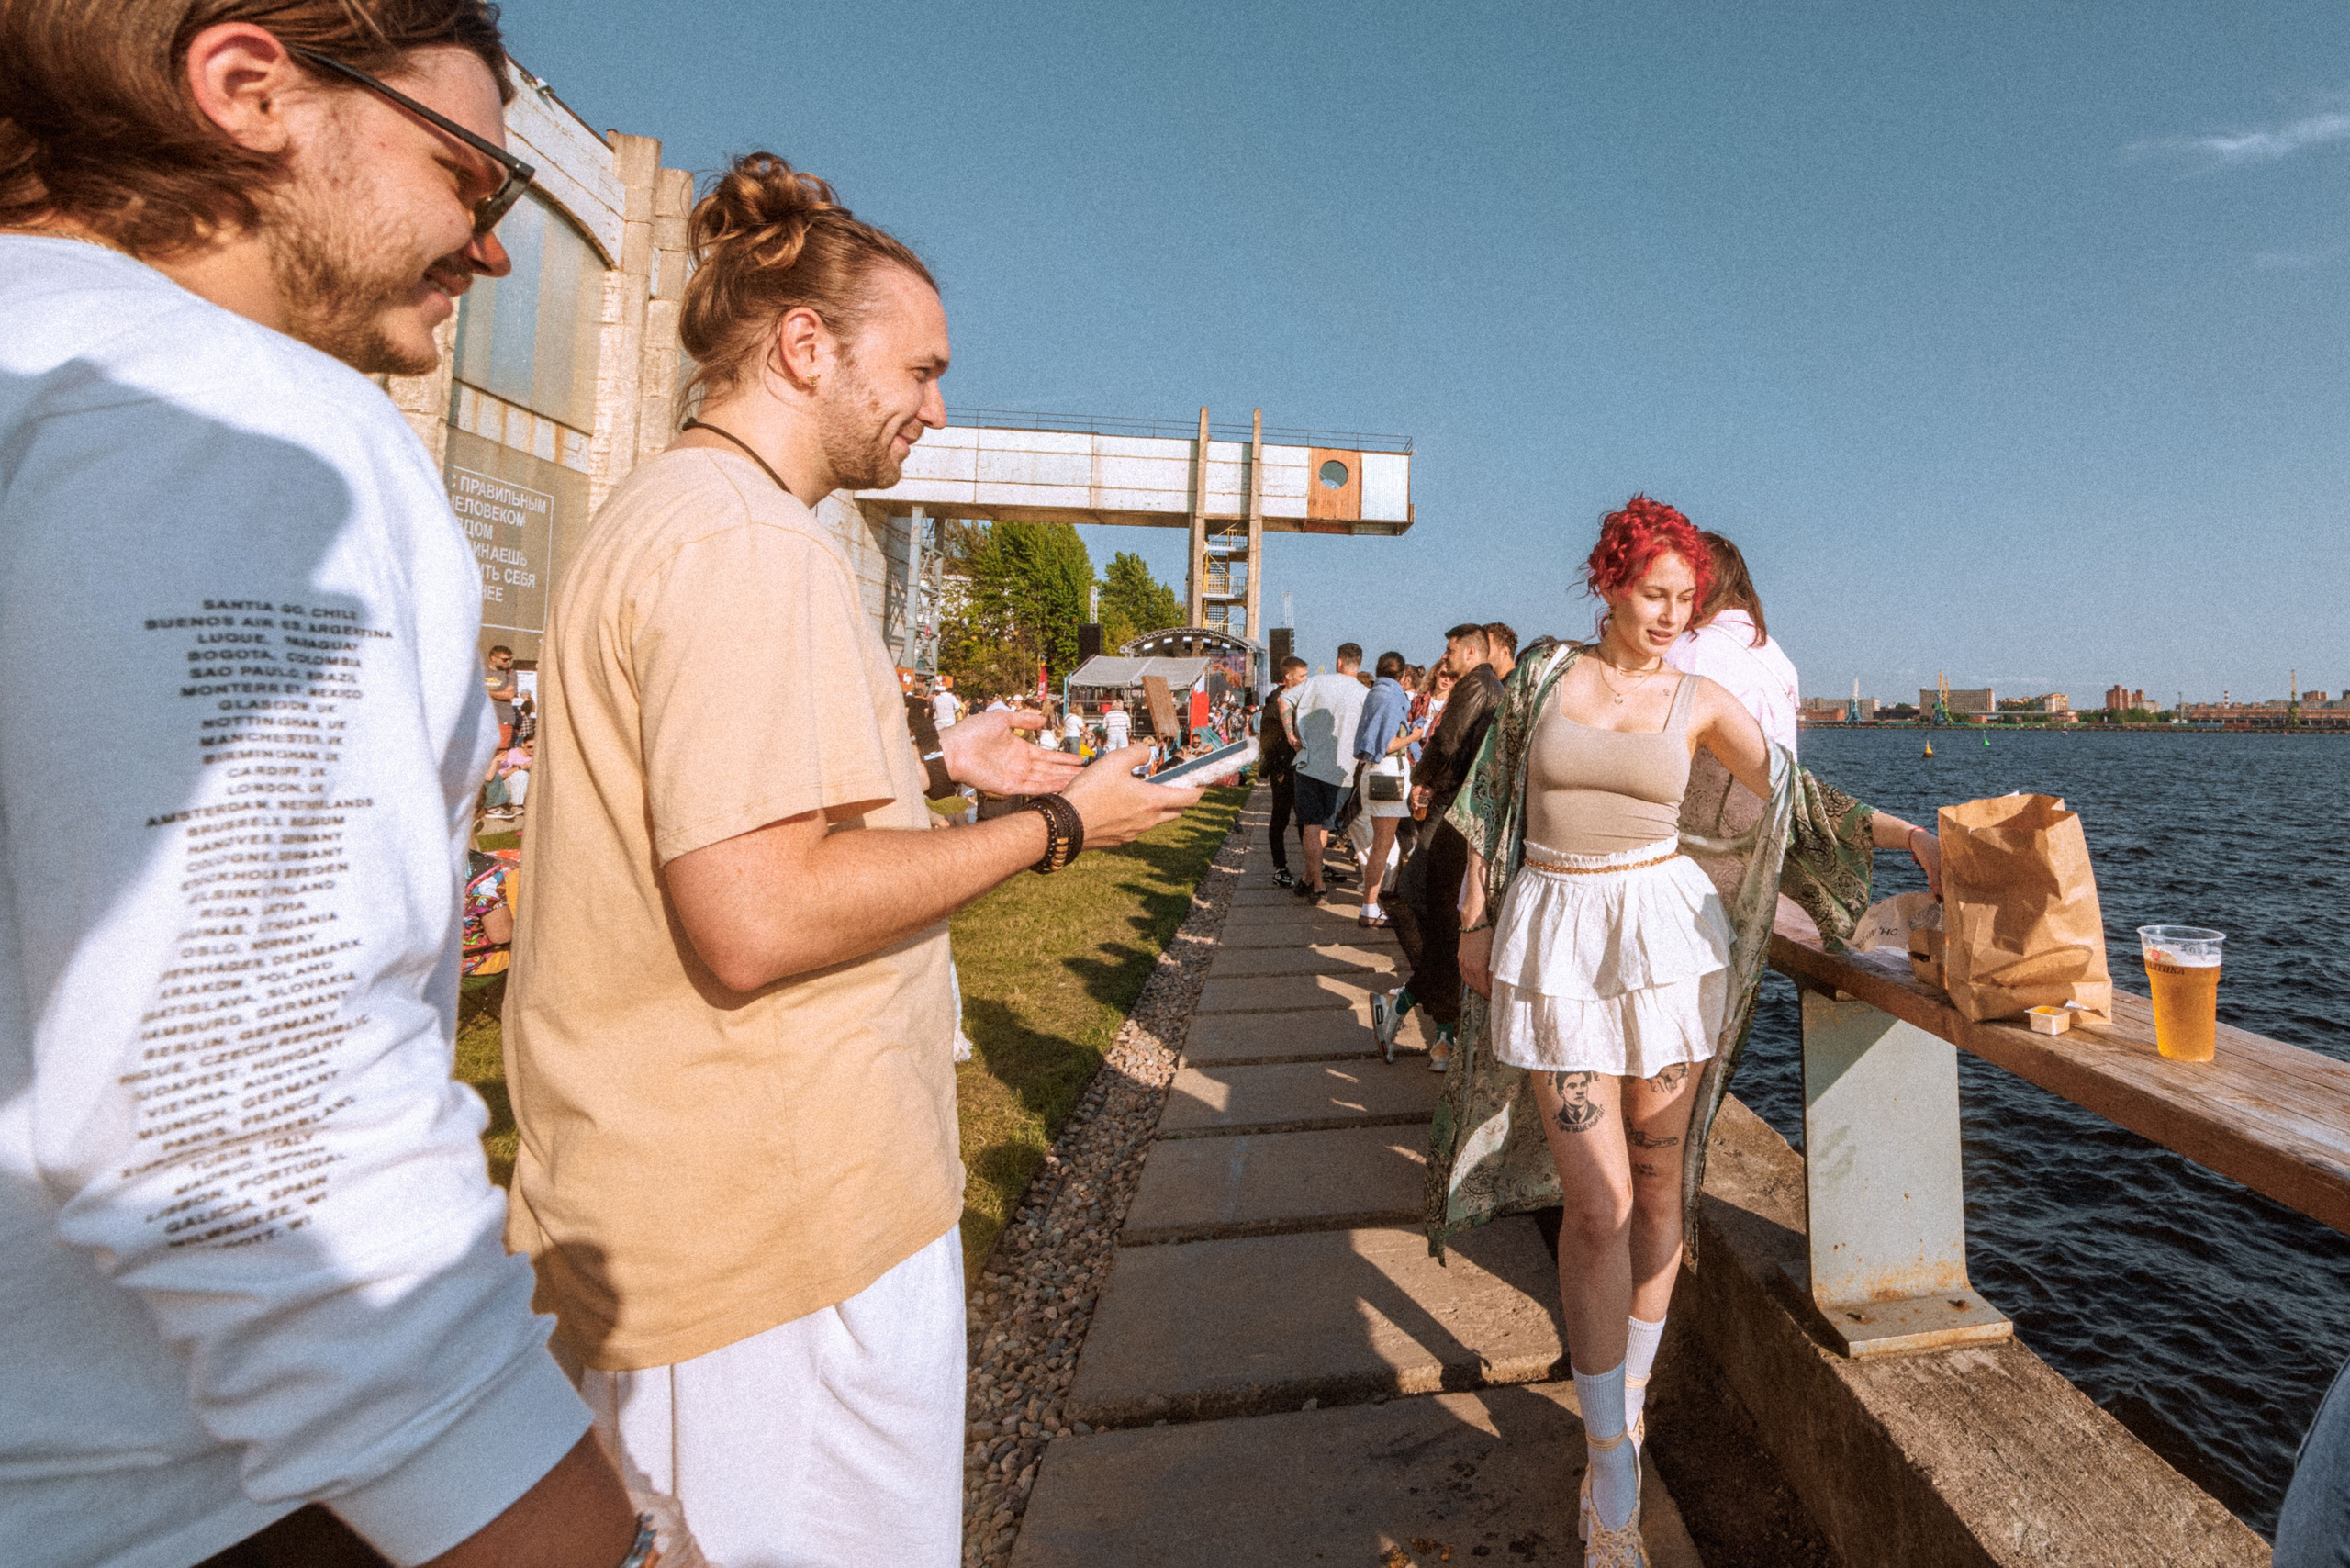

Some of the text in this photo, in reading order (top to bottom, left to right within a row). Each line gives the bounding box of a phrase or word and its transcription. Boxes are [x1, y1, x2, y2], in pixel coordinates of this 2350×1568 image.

[460, 476, 546, 514] ПРАВИЛЬНЫМ
[471, 541, 528, 566] ИНАЕШЬ
[504, 568, 536, 588] СЕБЯ
[145, 616, 235, 631] BUENOS
